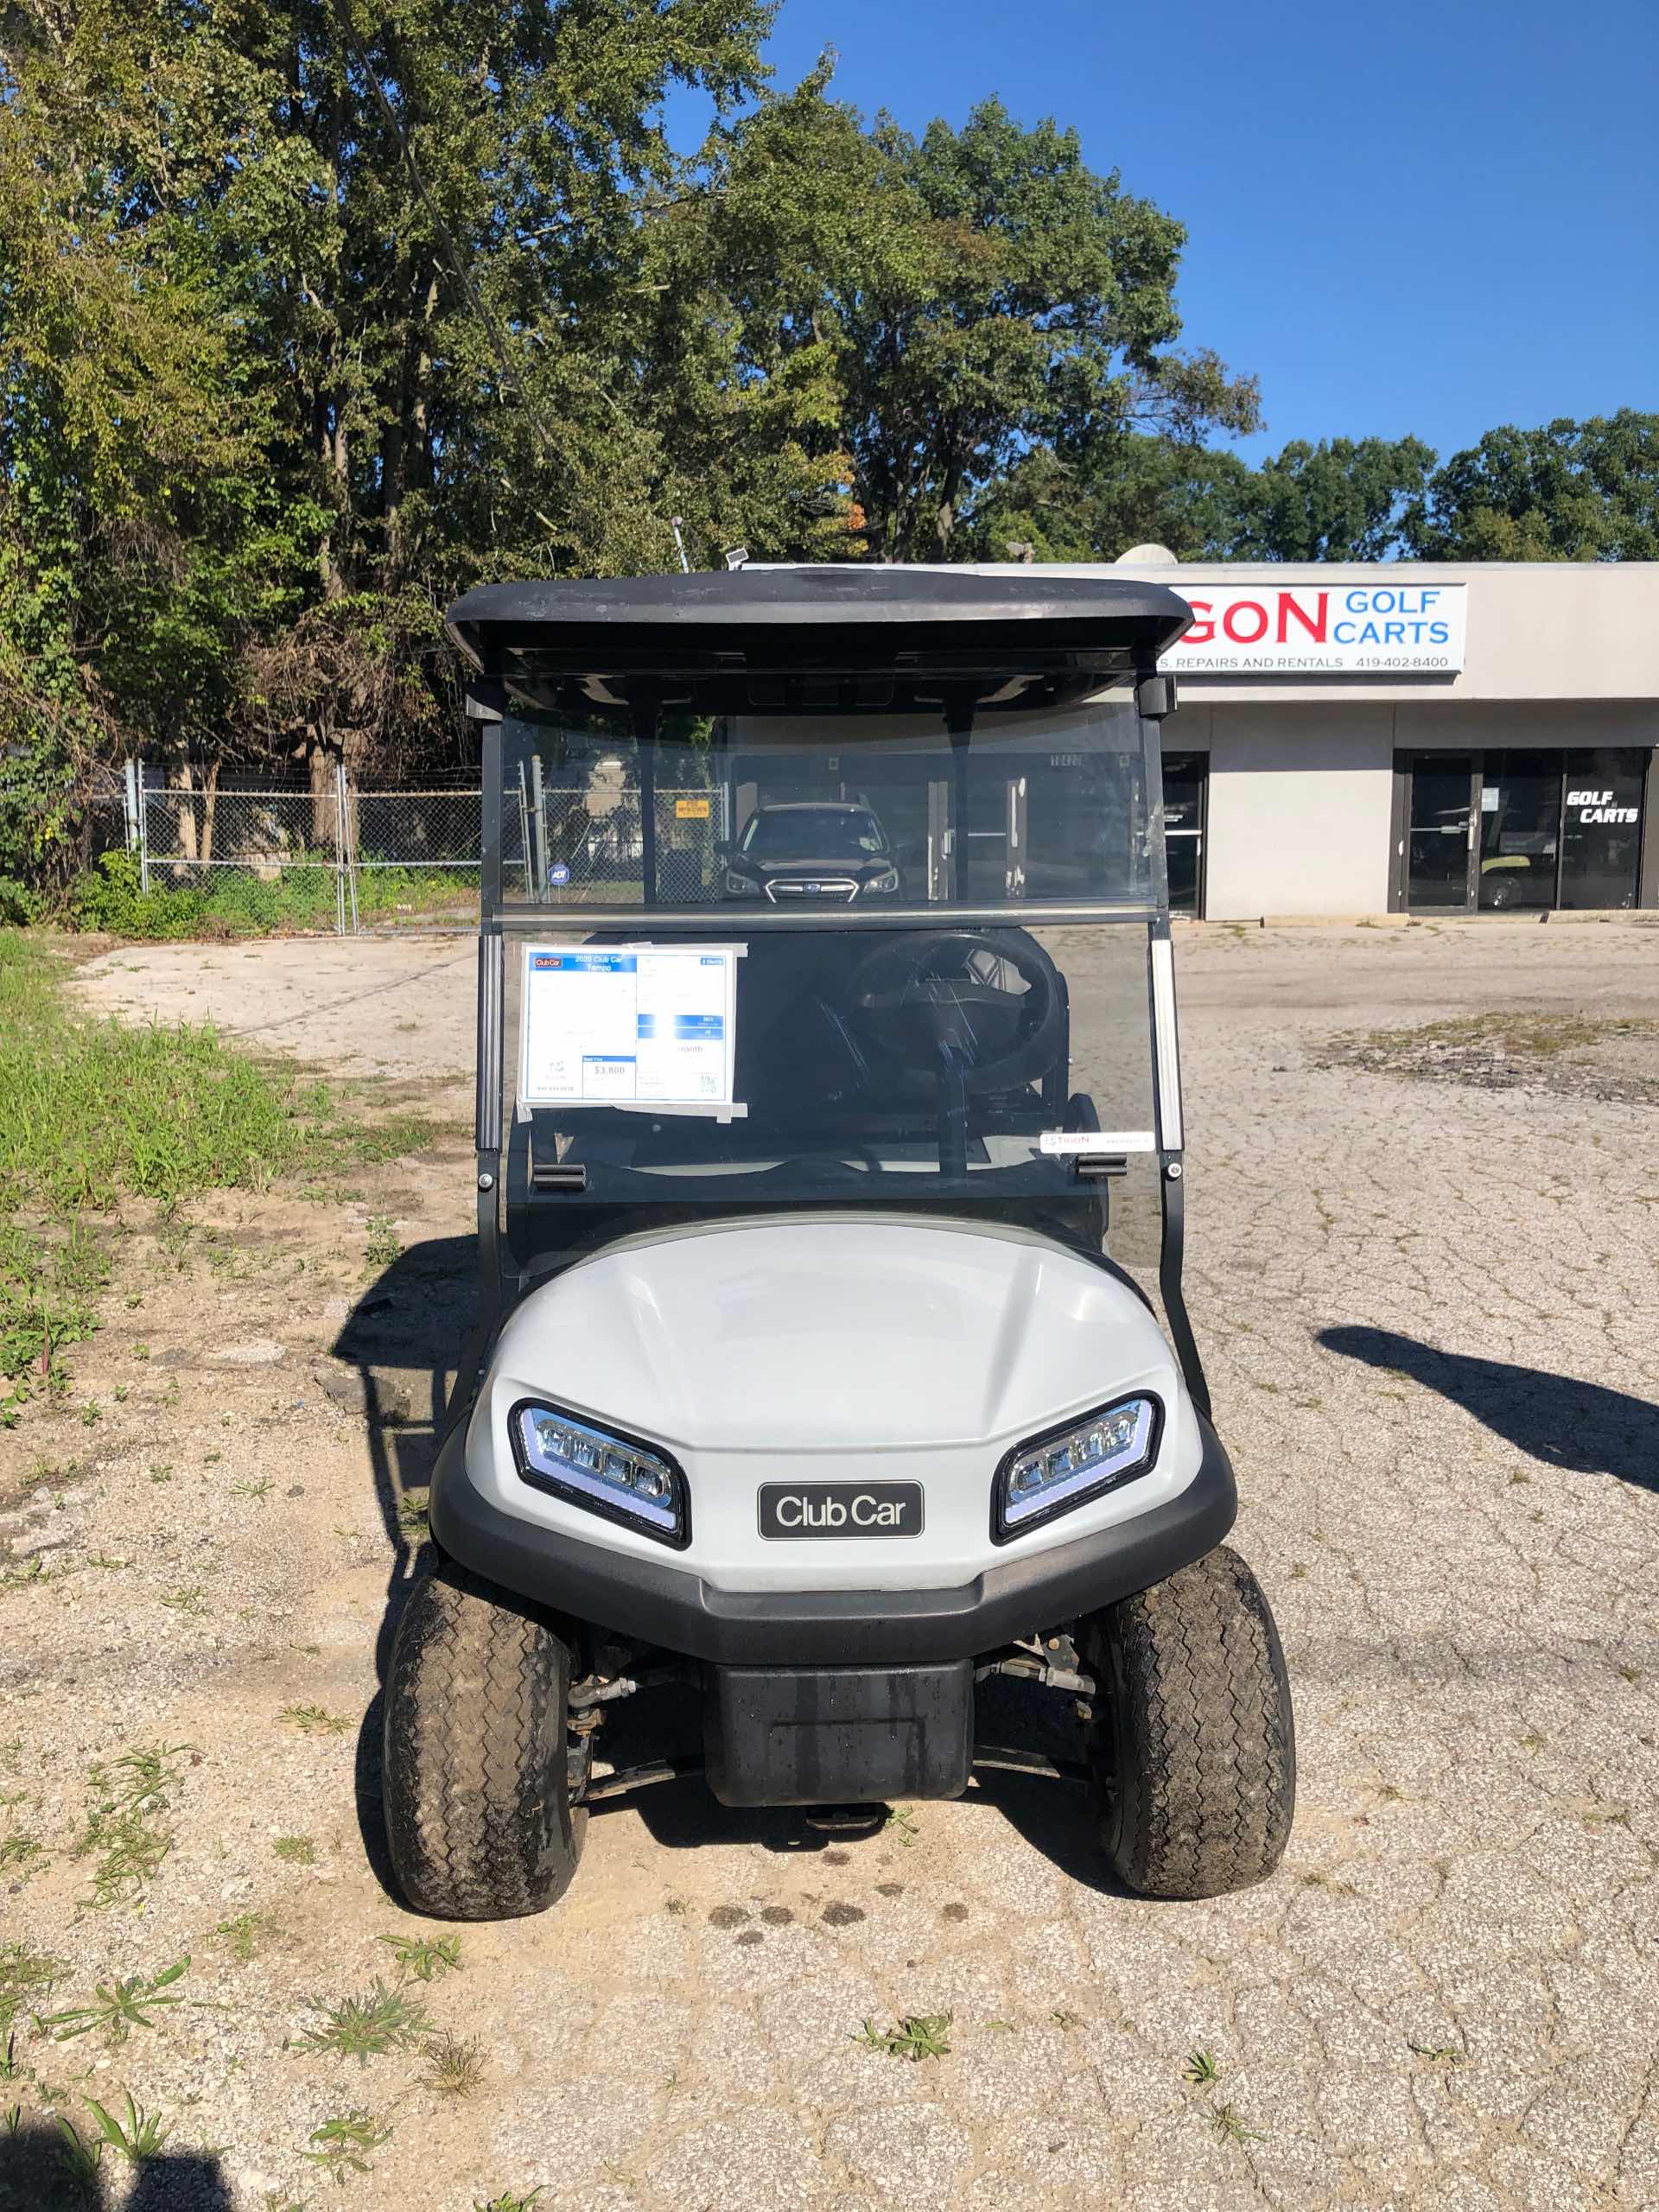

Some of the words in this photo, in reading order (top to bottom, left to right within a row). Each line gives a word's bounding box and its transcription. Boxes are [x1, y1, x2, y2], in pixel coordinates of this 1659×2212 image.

[1345, 591, 1441, 613] GOLF
[1333, 621, 1449, 645] CARTS
[1176, 658, 1238, 669] REPAIRS
[1243, 658, 1274, 668] AND
[1277, 658, 1344, 668] RENTALS
[1356, 657, 1449, 668] 419-402-8400
[1567, 791, 1614, 805] GOLF
[1580, 808, 1639, 823] CARTS
[776, 1496, 848, 1527] Club
[851, 1495, 906, 1526] Car
